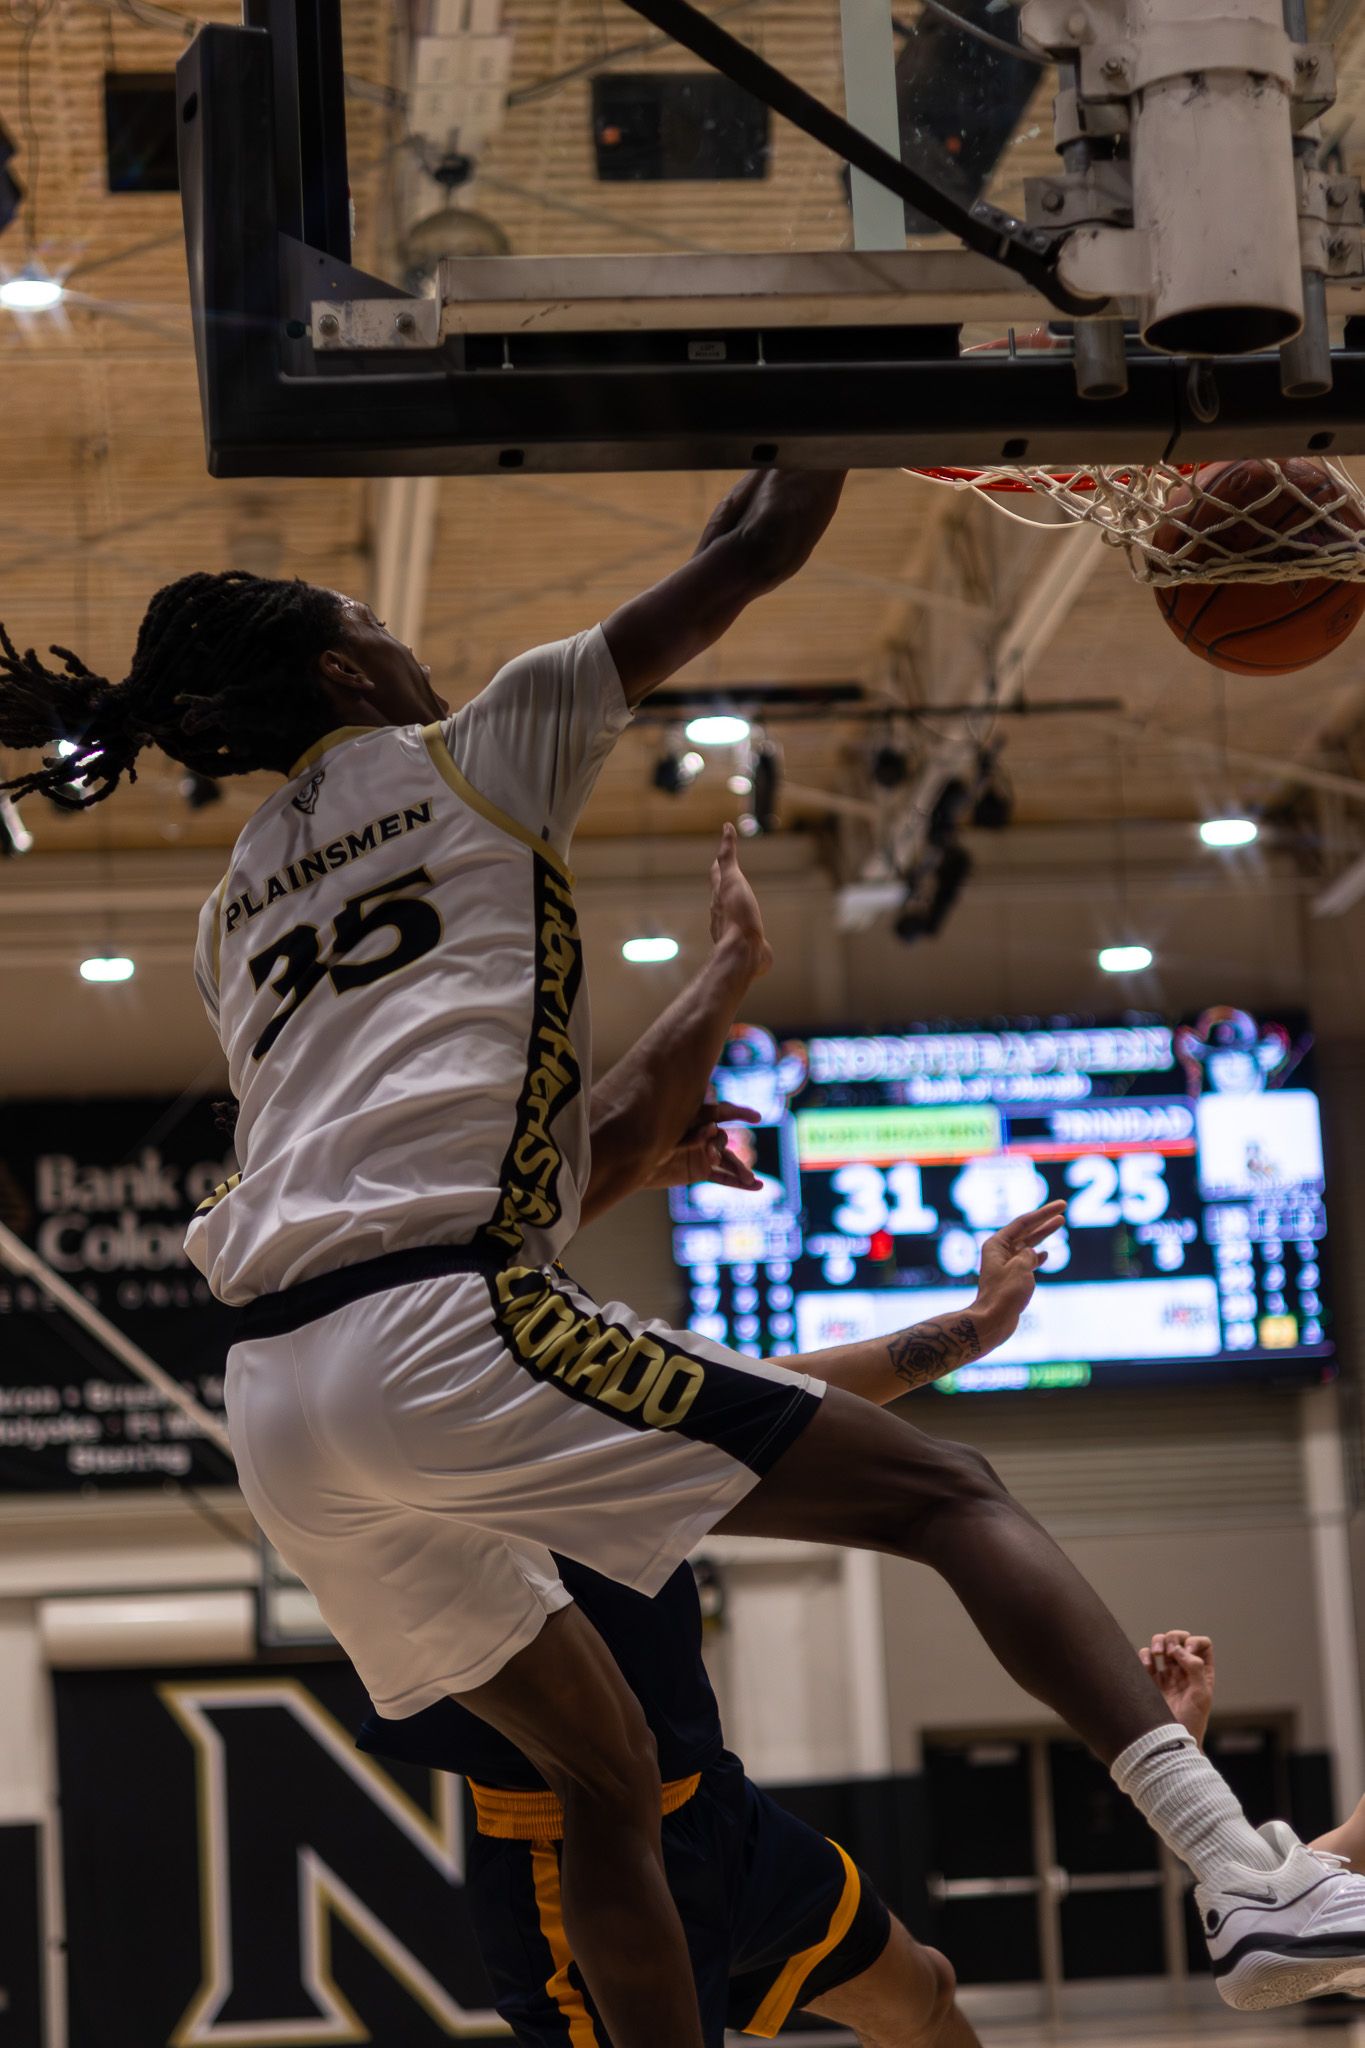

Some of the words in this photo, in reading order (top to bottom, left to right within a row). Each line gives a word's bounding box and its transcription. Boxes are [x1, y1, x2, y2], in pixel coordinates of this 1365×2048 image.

[225, 799, 434, 938] PLAINSMEN
[248, 865, 444, 1062] 35
[38, 1149, 177, 1211] Bank
[187, 1150, 240, 1206] o
[832, 1162, 939, 1236] 31
[1065, 1152, 1169, 1228] 25
[38, 1211, 190, 1273] Colo
[495, 1266, 705, 1428] CORADO
